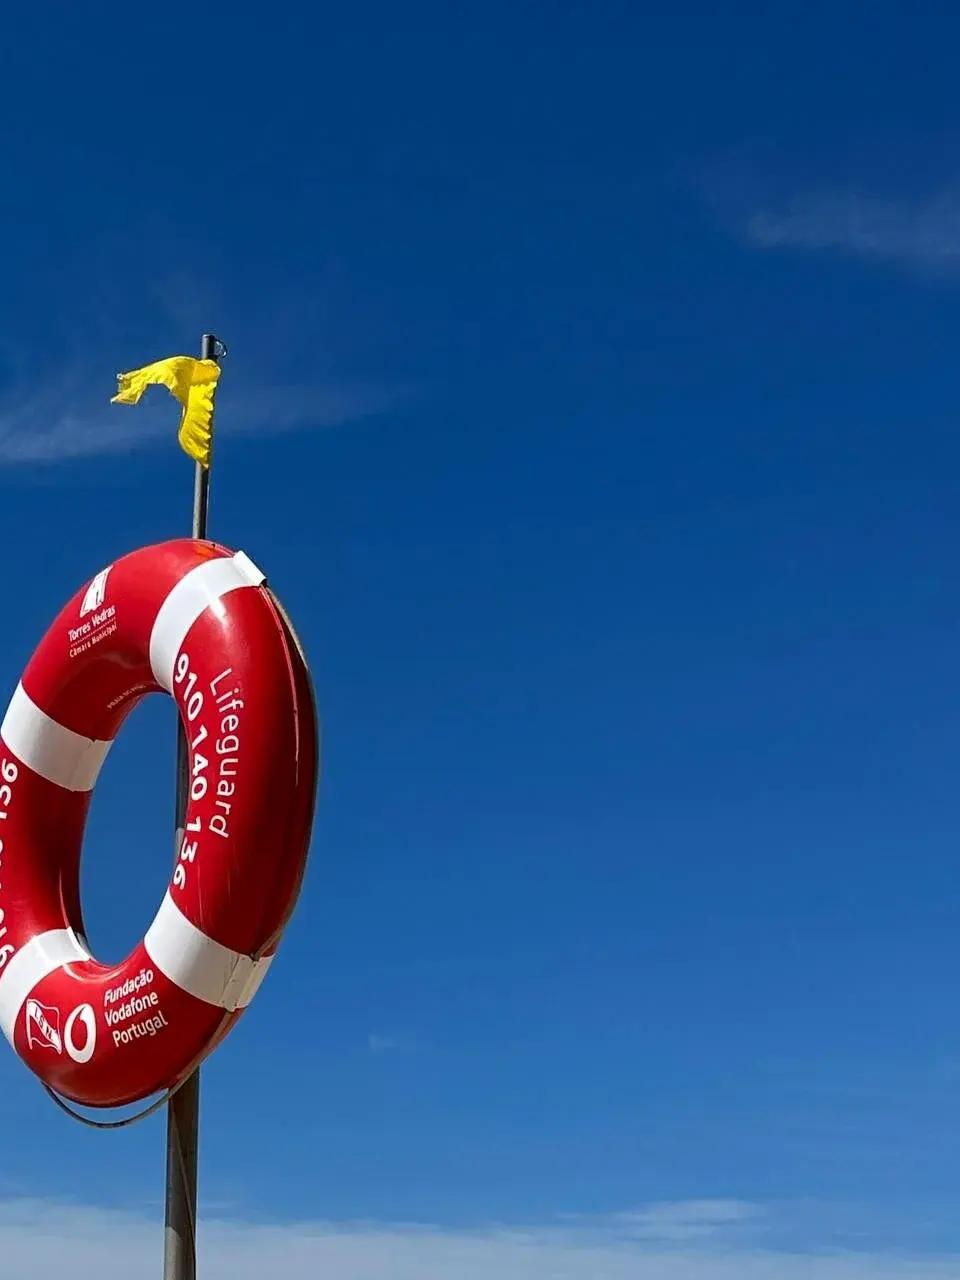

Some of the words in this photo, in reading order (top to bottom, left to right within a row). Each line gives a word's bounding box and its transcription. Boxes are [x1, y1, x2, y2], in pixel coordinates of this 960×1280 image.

[67, 622, 90, 642] Torres
[91, 605, 116, 626] Vedras
[175, 653, 203, 721] 910
[191, 725, 209, 801] 140
[209, 667, 244, 838] Lifeguard
[173, 816, 202, 890] 136
[103, 968, 154, 1007] Fundação
[104, 991, 159, 1027] Vodafone
[112, 1010, 168, 1047] Portugal
